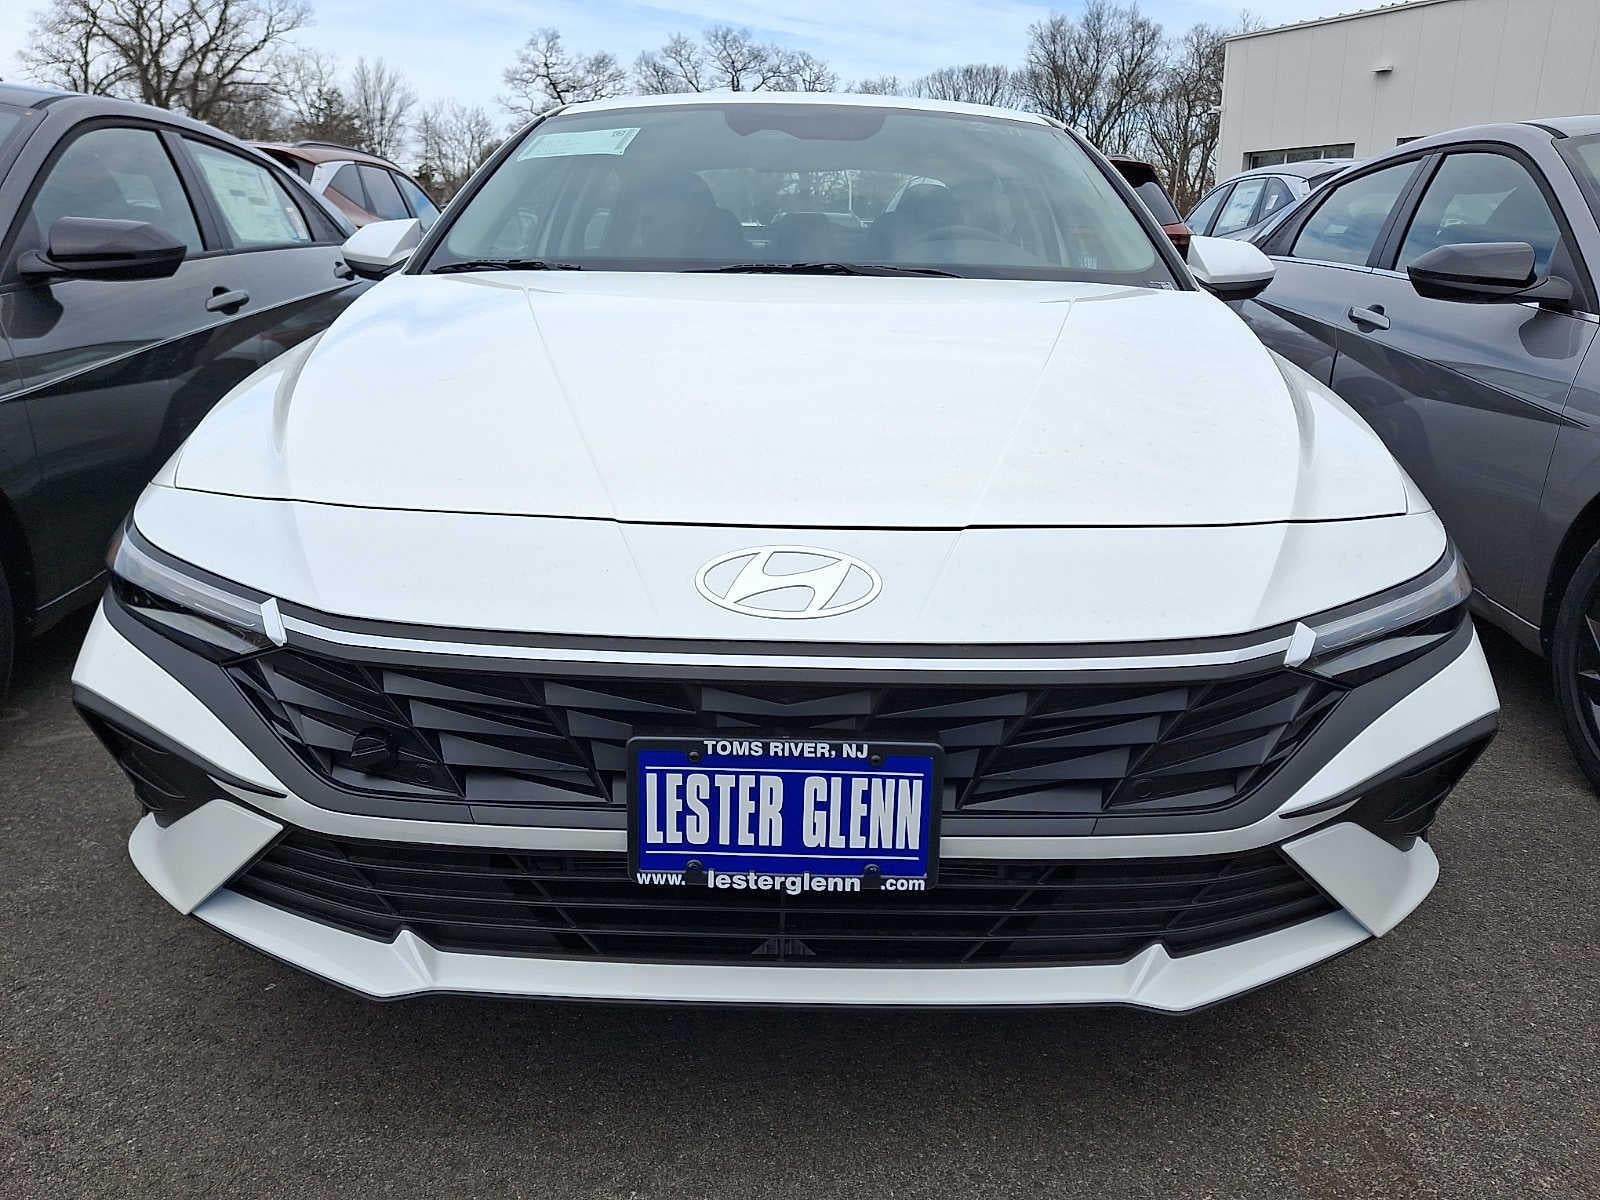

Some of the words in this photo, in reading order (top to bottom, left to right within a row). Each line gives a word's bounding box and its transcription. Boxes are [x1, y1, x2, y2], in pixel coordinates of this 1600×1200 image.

[704, 740, 763, 757] TOMS
[769, 741, 836, 759] RIVER,
[842, 744, 869, 759] NJ
[645, 773, 783, 846] LESTER
[802, 776, 923, 850] GLENN
[636, 873, 686, 886] www.
[707, 870, 861, 895] lesterglenn
[880, 877, 926, 891] .com
